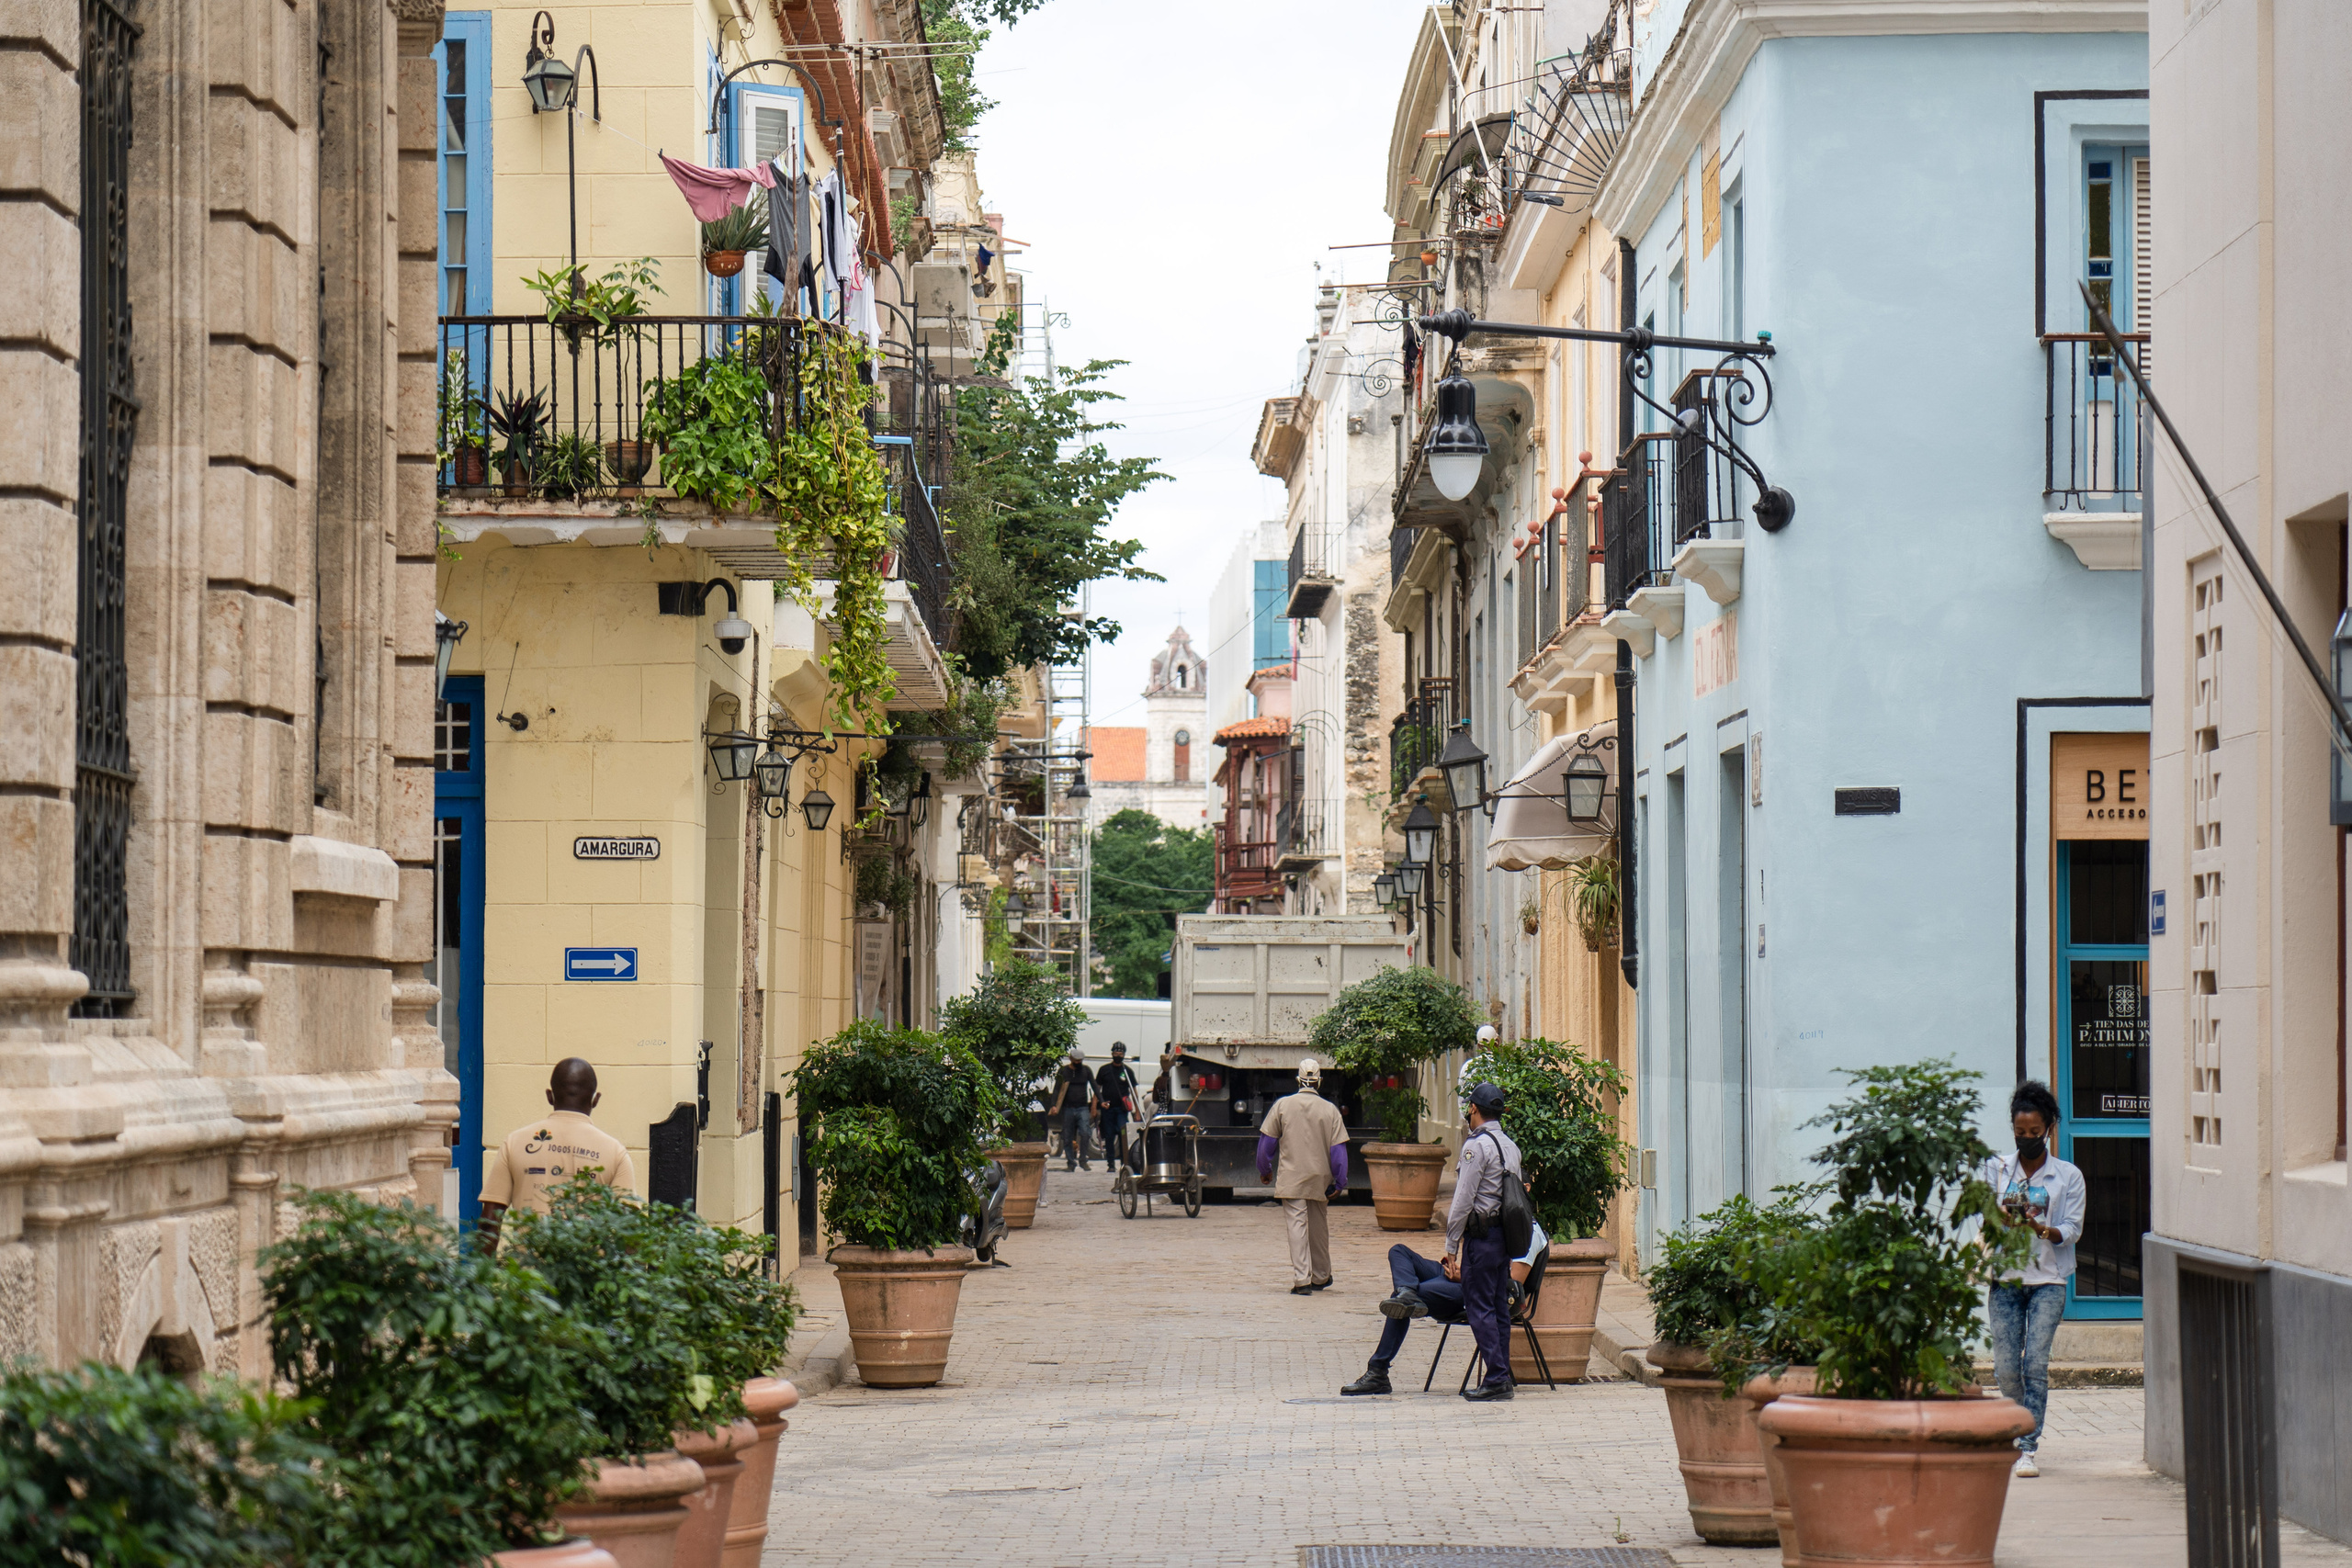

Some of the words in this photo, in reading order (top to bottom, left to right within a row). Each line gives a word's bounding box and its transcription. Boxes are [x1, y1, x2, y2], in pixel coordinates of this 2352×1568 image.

[2086, 769, 2150, 802] BE
[580, 841, 654, 855] AMARGURA
[2094, 1020, 2134, 1028] TIENDAS
[2137, 1020, 2150, 1028] DE
[2105, 1099, 2151, 1109] ABIERTO
[548, 1144, 571, 1154] JOGOS
[572, 1145, 600, 1158] LIMPOS
